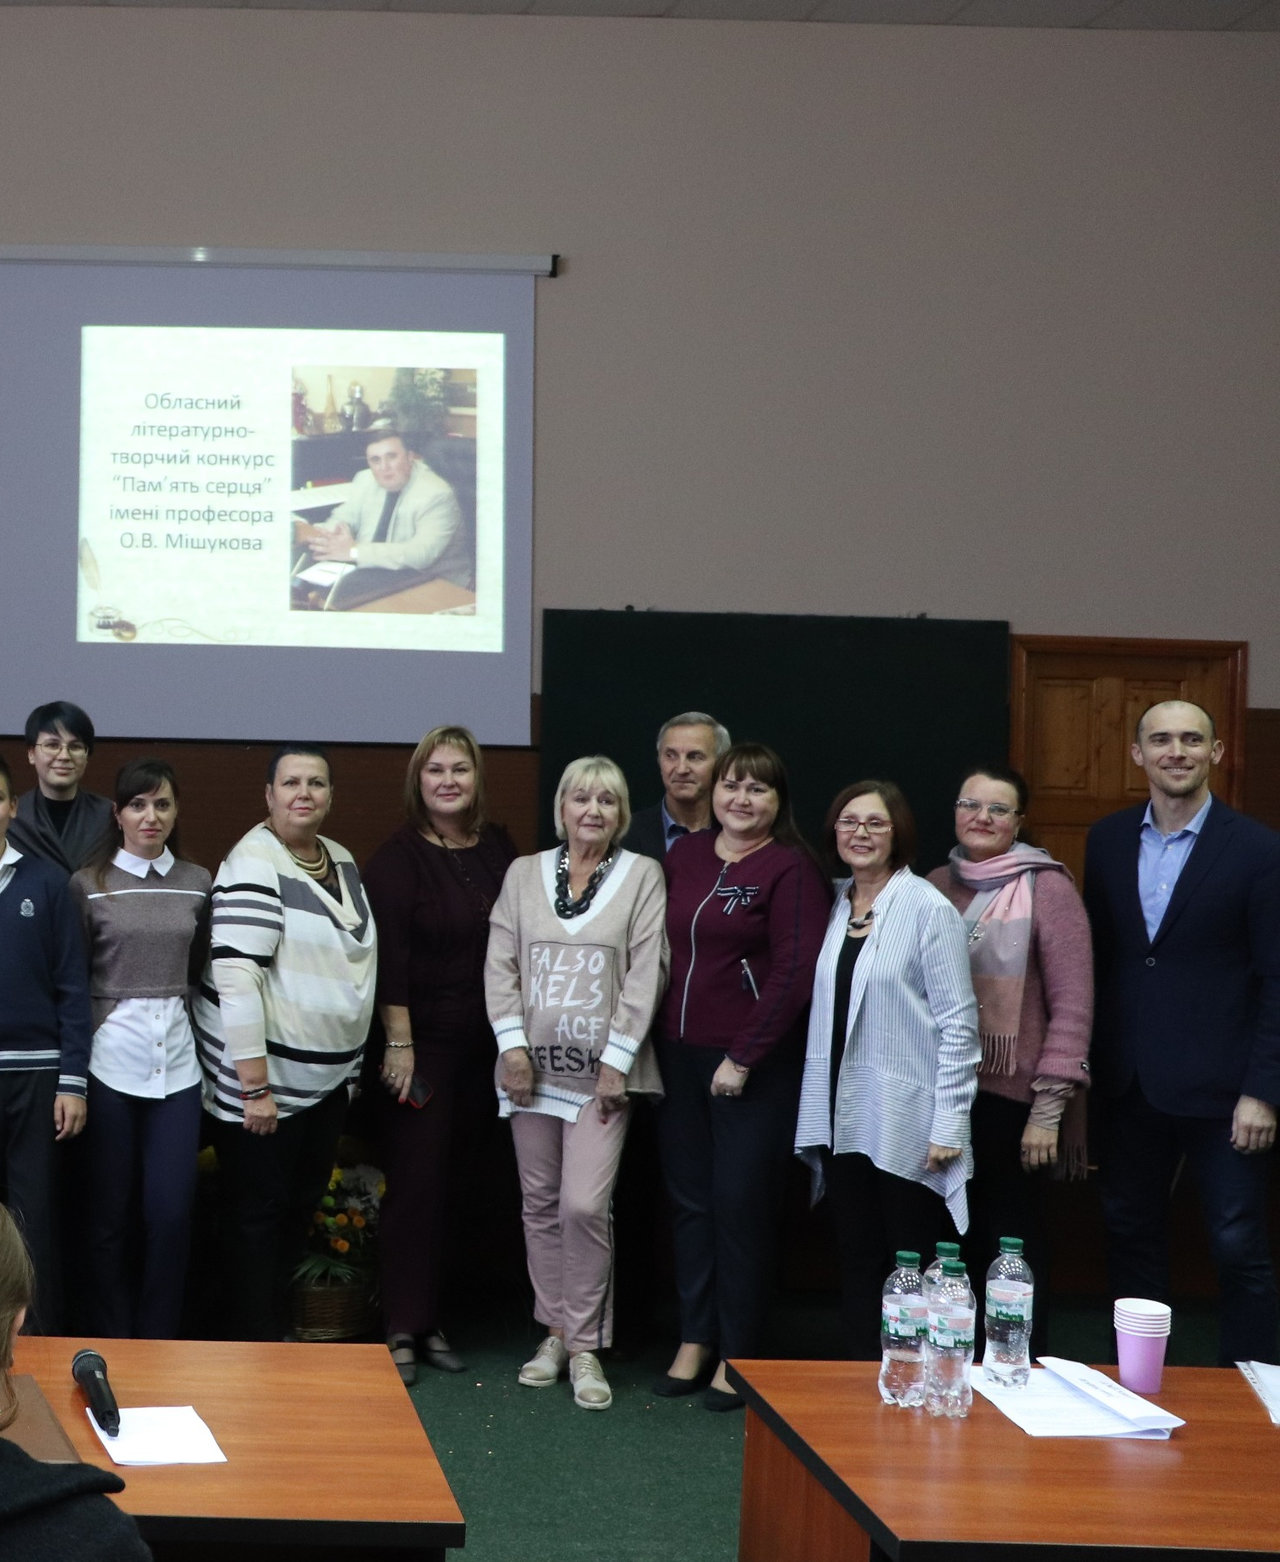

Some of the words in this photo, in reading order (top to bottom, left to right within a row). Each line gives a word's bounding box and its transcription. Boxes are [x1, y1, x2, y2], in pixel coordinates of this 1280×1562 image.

[144, 392, 242, 411] Обласний
[130, 422, 255, 441] літературно-
[110, 449, 191, 469] творчий
[197, 453, 275, 470] конкурс
[109, 505, 159, 521] імені
[165, 505, 274, 526] професора
[120, 532, 159, 551] О.В.
[165, 533, 263, 553] Мішукова
